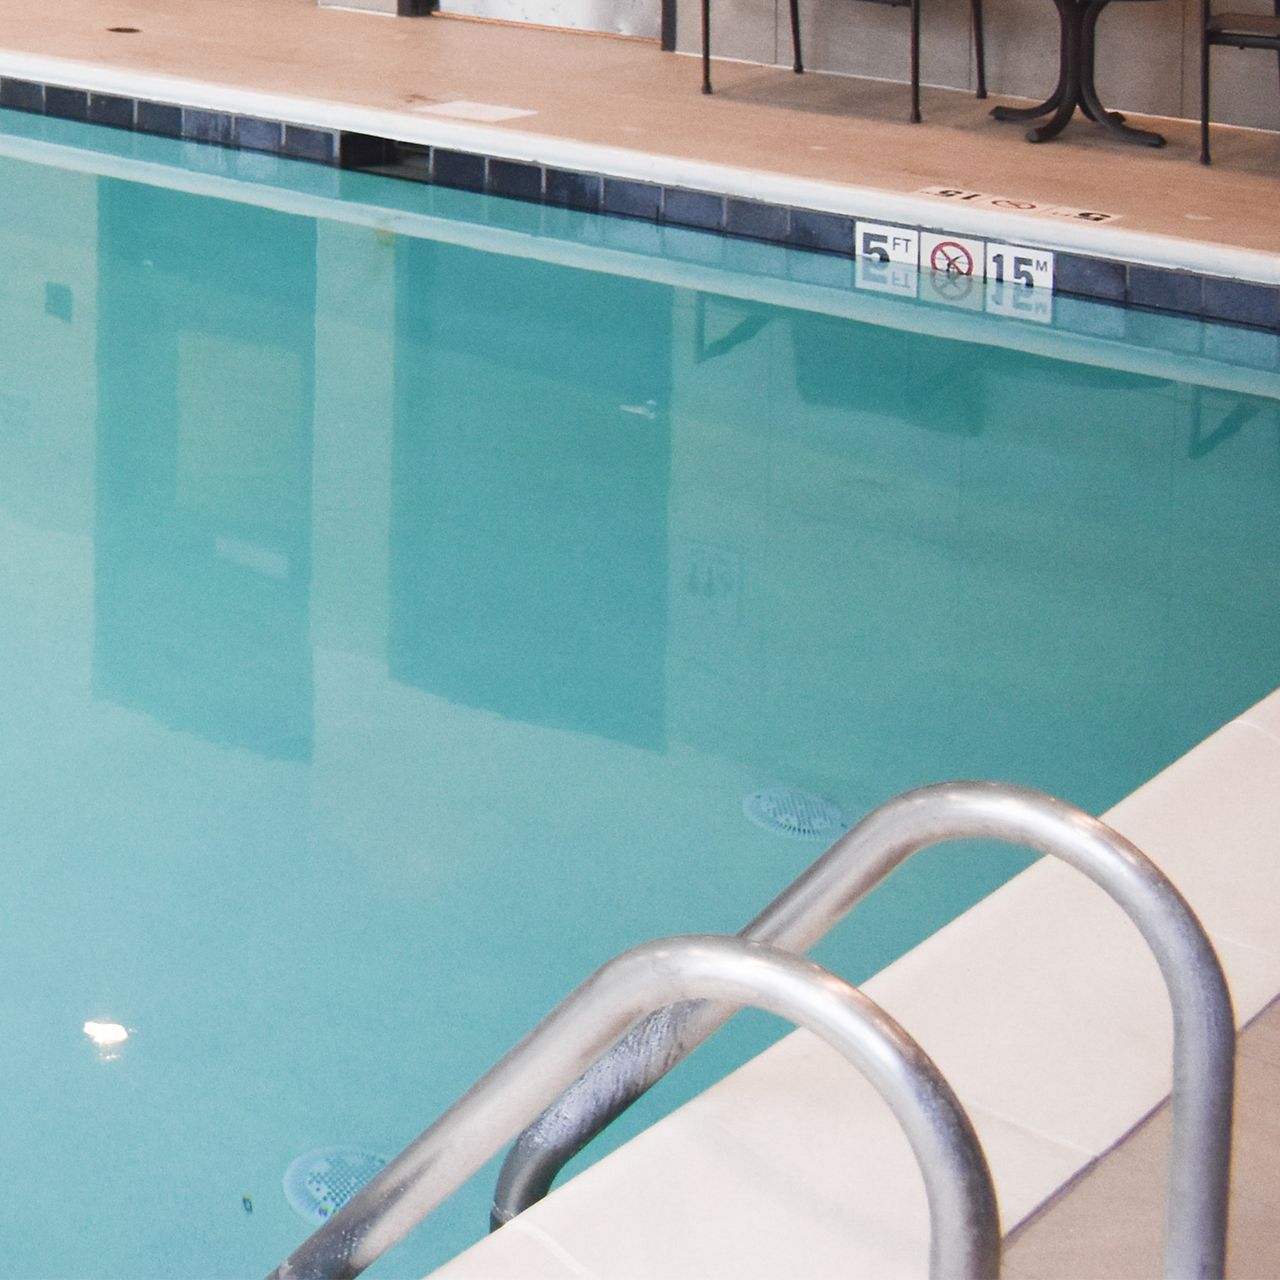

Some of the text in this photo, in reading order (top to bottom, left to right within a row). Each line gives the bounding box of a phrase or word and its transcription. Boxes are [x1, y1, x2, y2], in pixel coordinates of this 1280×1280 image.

[862, 231, 913, 263] 5 FT
[1035, 259, 1049, 273] M
